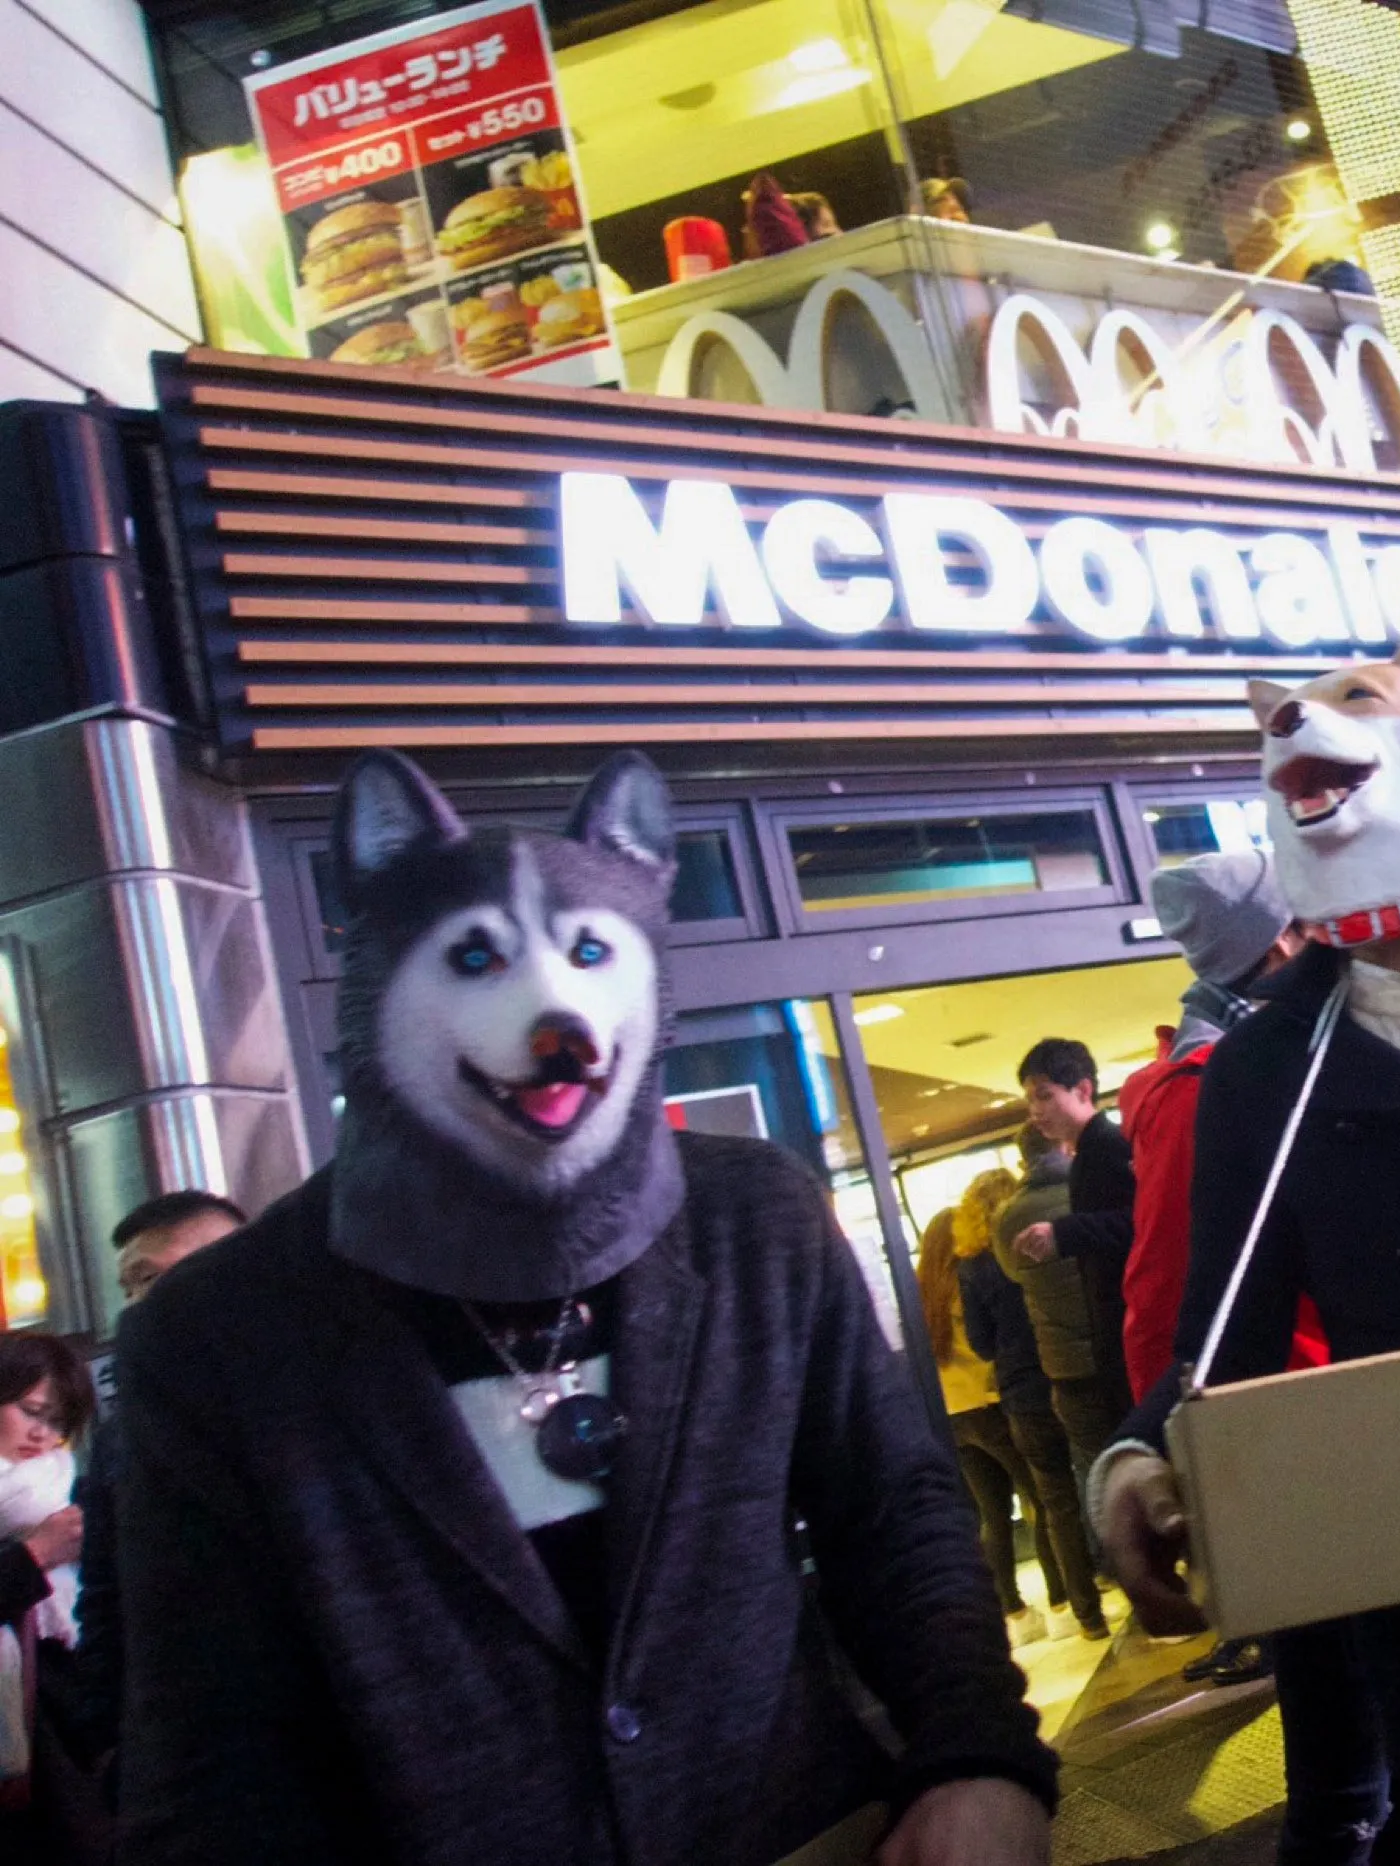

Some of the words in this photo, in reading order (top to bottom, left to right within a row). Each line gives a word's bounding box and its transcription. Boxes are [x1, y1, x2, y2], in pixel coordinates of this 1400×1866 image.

[294, 34, 507, 128] バリューランチ
